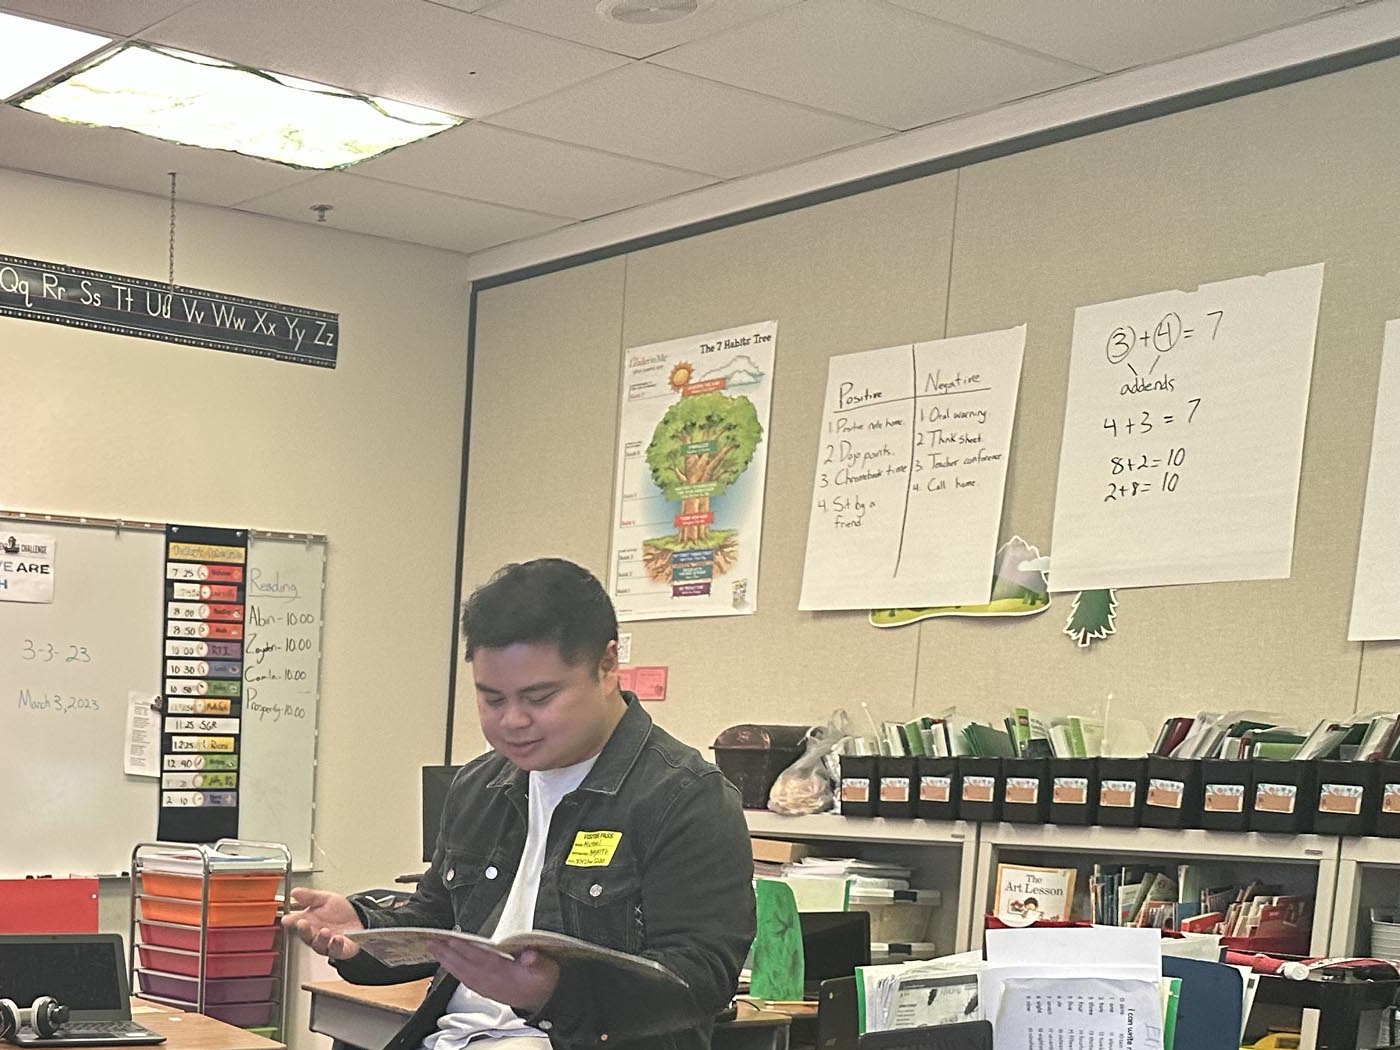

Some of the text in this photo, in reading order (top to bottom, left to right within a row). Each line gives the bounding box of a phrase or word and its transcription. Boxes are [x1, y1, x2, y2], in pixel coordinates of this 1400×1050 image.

[0, 267, 32, 308] Qq
[43, 274, 66, 300] Rr
[80, 281, 100, 307] Ss
[112, 285, 133, 311] Tt
[183, 299, 204, 324] Vv
[212, 303, 245, 331] Ww
[253, 312, 276, 336] Xx
[285, 316, 305, 350] Yy
[314, 322, 334, 346] Zz
[699, 333, 772, 354] The 7 Habits Tree
[1120, 373, 1176, 396] addends
[17, 563, 50, 574] ARE
[250, 568, 298, 603] Reading
[18, 689, 50, 710] March
[69, 697, 99, 711] 2023
[1005, 881, 1064, 897] Art Lesson
[1025, 874, 1043, 884] The
[1126, 1027, 1134, 1045] write
